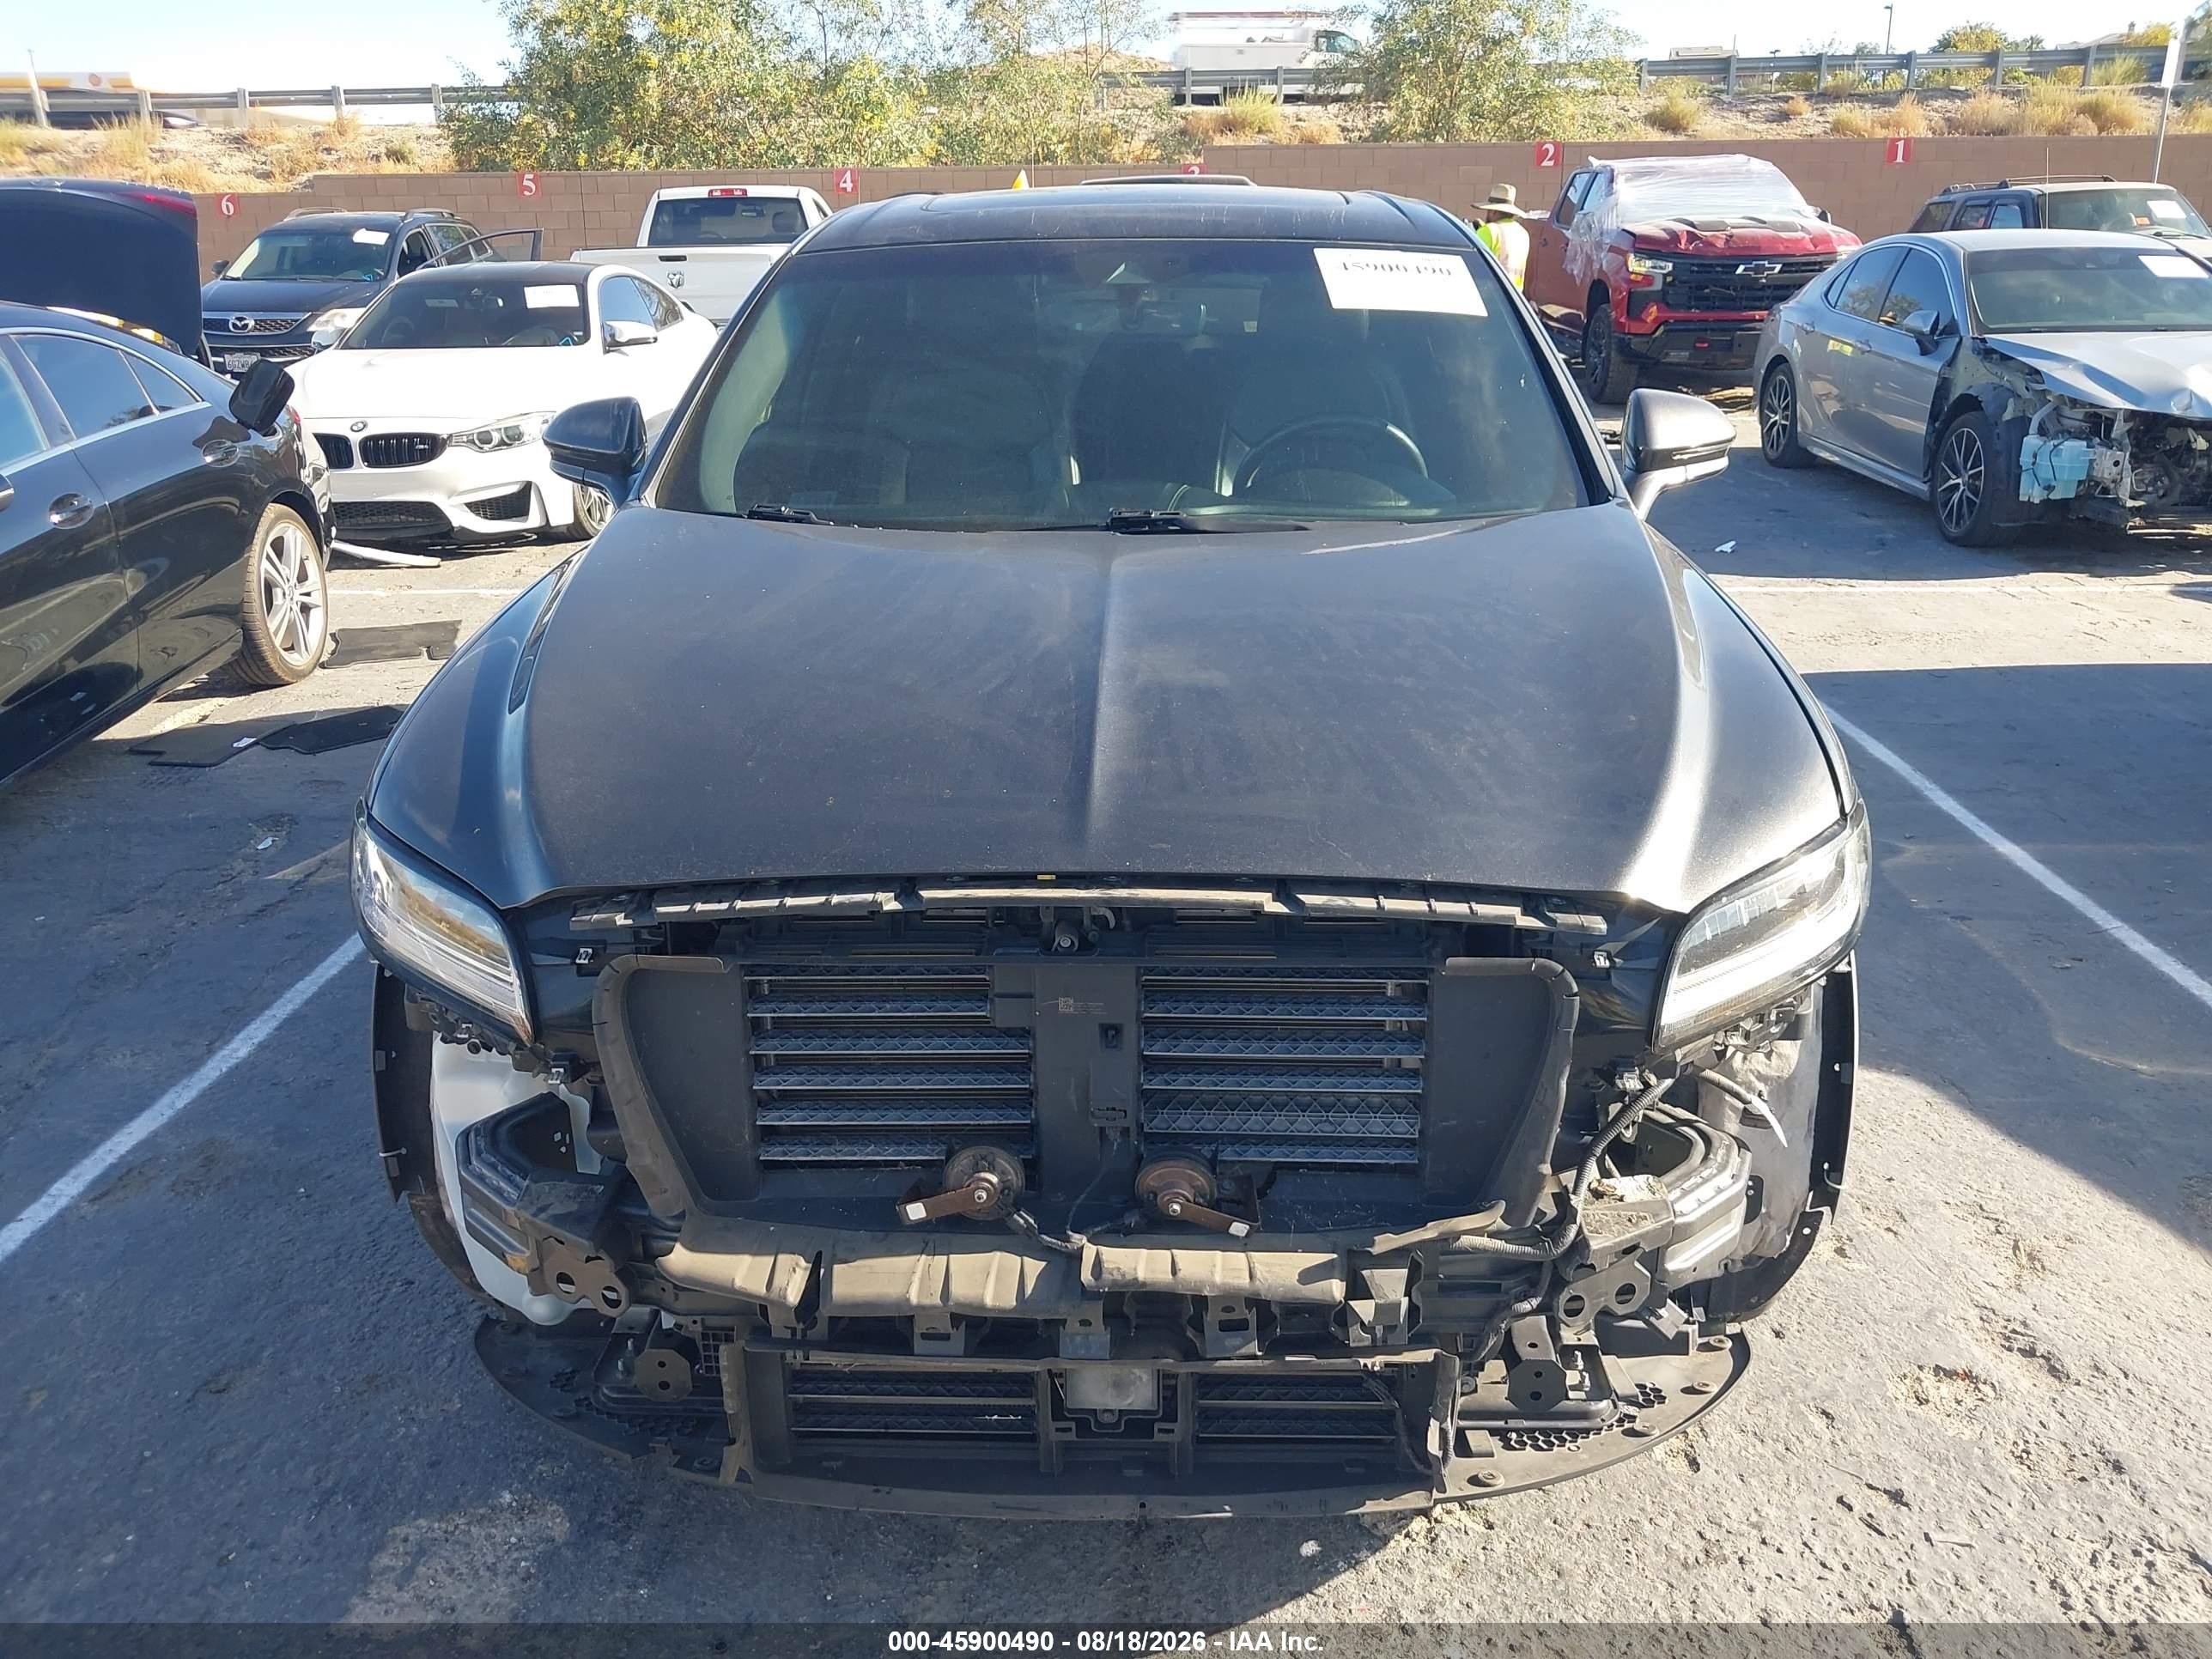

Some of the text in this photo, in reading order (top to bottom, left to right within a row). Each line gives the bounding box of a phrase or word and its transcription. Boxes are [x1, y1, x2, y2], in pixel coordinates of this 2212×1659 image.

[1541, 143, 1555, 167] 2
[1893, 139, 1905, 163] 1
[522, 173, 536, 196] 5
[839, 169, 854, 192] 4
[221, 193, 234, 216] 6
